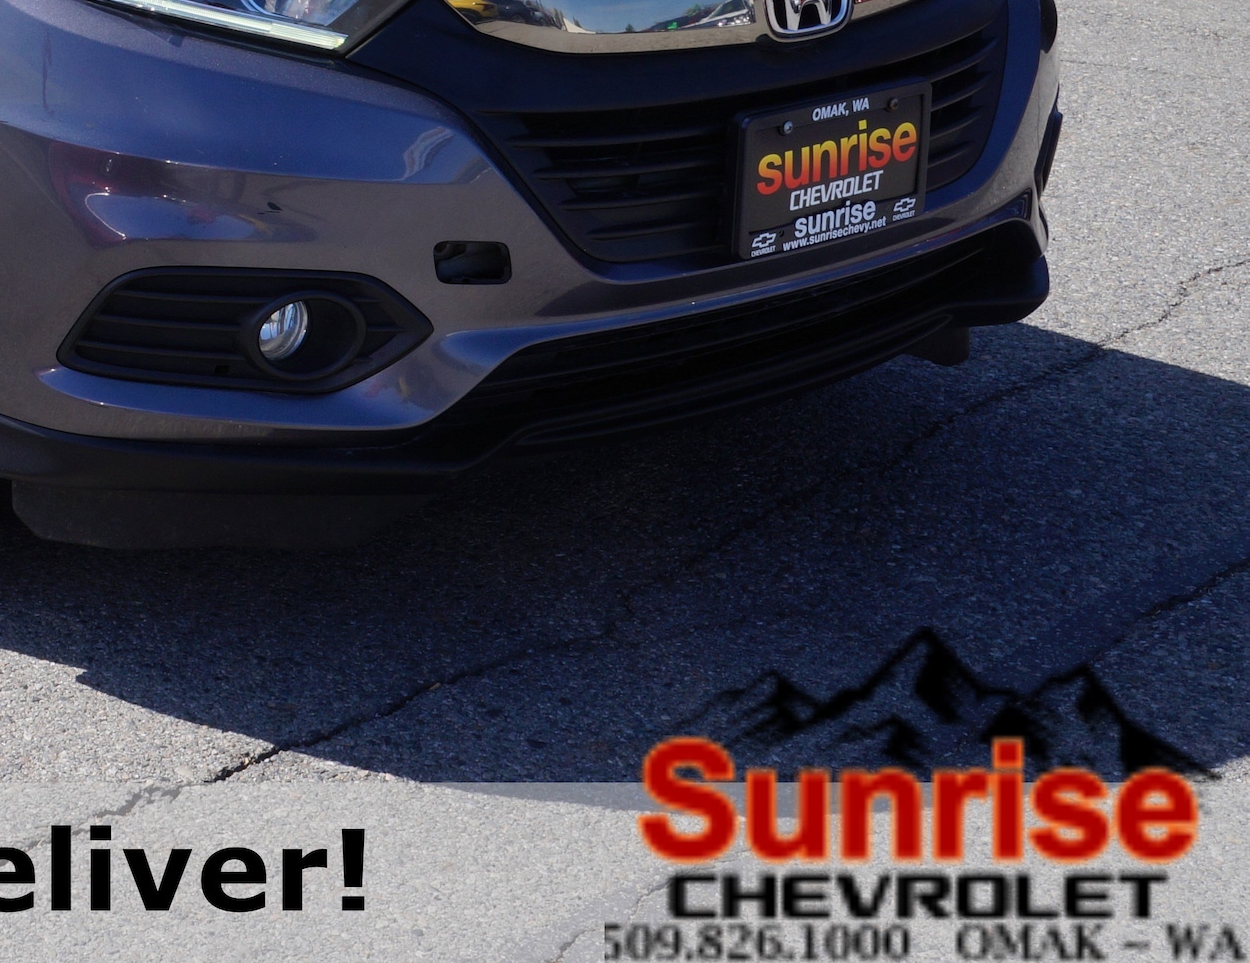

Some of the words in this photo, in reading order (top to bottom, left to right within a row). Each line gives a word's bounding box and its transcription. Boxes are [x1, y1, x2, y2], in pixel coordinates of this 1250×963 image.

[812, 102, 850, 121] OMAK,
[852, 97, 870, 113] WA
[756, 119, 918, 195] sunrise
[789, 170, 884, 211] CHEVROLET
[782, 215, 887, 252] www.sunrisechevy.net
[794, 200, 876, 237] sunrise
[892, 210, 916, 221] CHEVROLET
[751, 245, 776, 257] CHEVROLET
